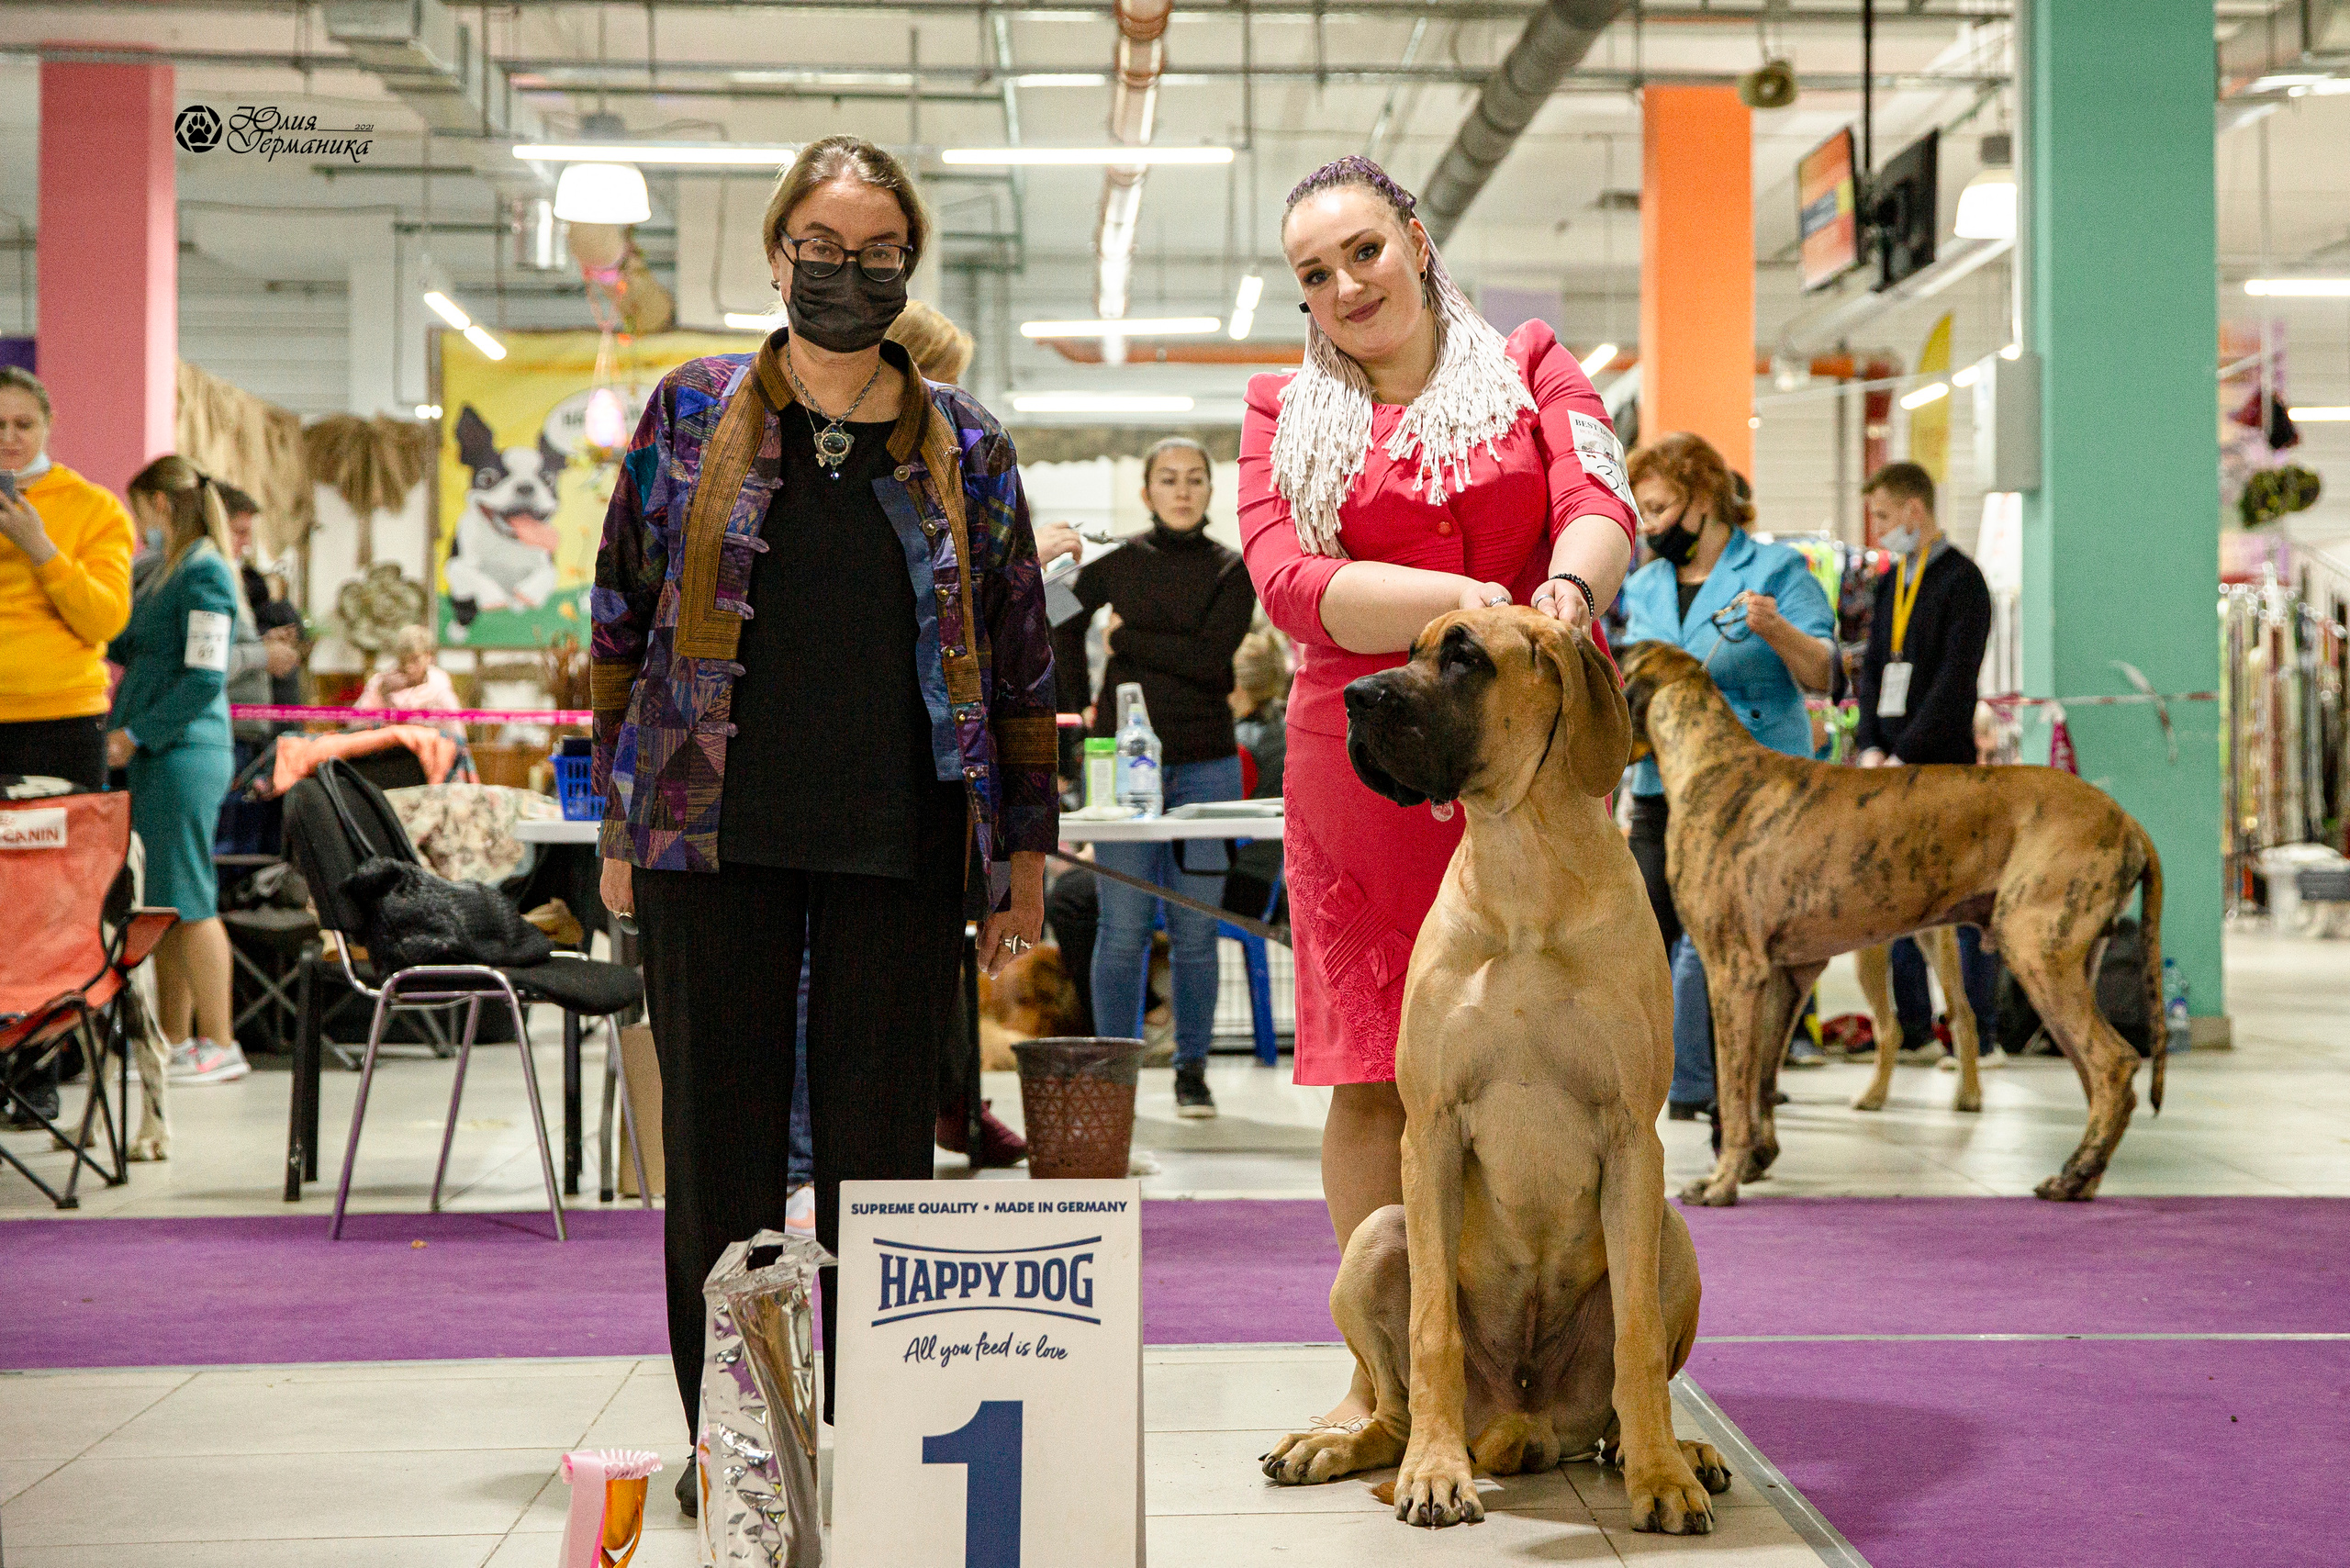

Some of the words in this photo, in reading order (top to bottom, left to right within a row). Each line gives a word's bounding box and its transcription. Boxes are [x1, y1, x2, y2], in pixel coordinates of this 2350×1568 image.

[852, 1203, 914, 1215] SUPREME
[918, 1203, 978, 1214] QUALITY
[995, 1202, 1034, 1213] MADE
[1038, 1203, 1053, 1213] IN
[1057, 1202, 1126, 1213] GERMANY
[878, 1252, 1009, 1311] HAPPY
[1014, 1252, 1093, 1308] DOG
[903, 1334, 936, 1363] All
[940, 1344, 971, 1367] you
[976, 1332, 1013, 1361] feed
[1016, 1342, 1030, 1356] is
[1035, 1335, 1067, 1360] love
[922, 1400, 1024, 1568] 1
